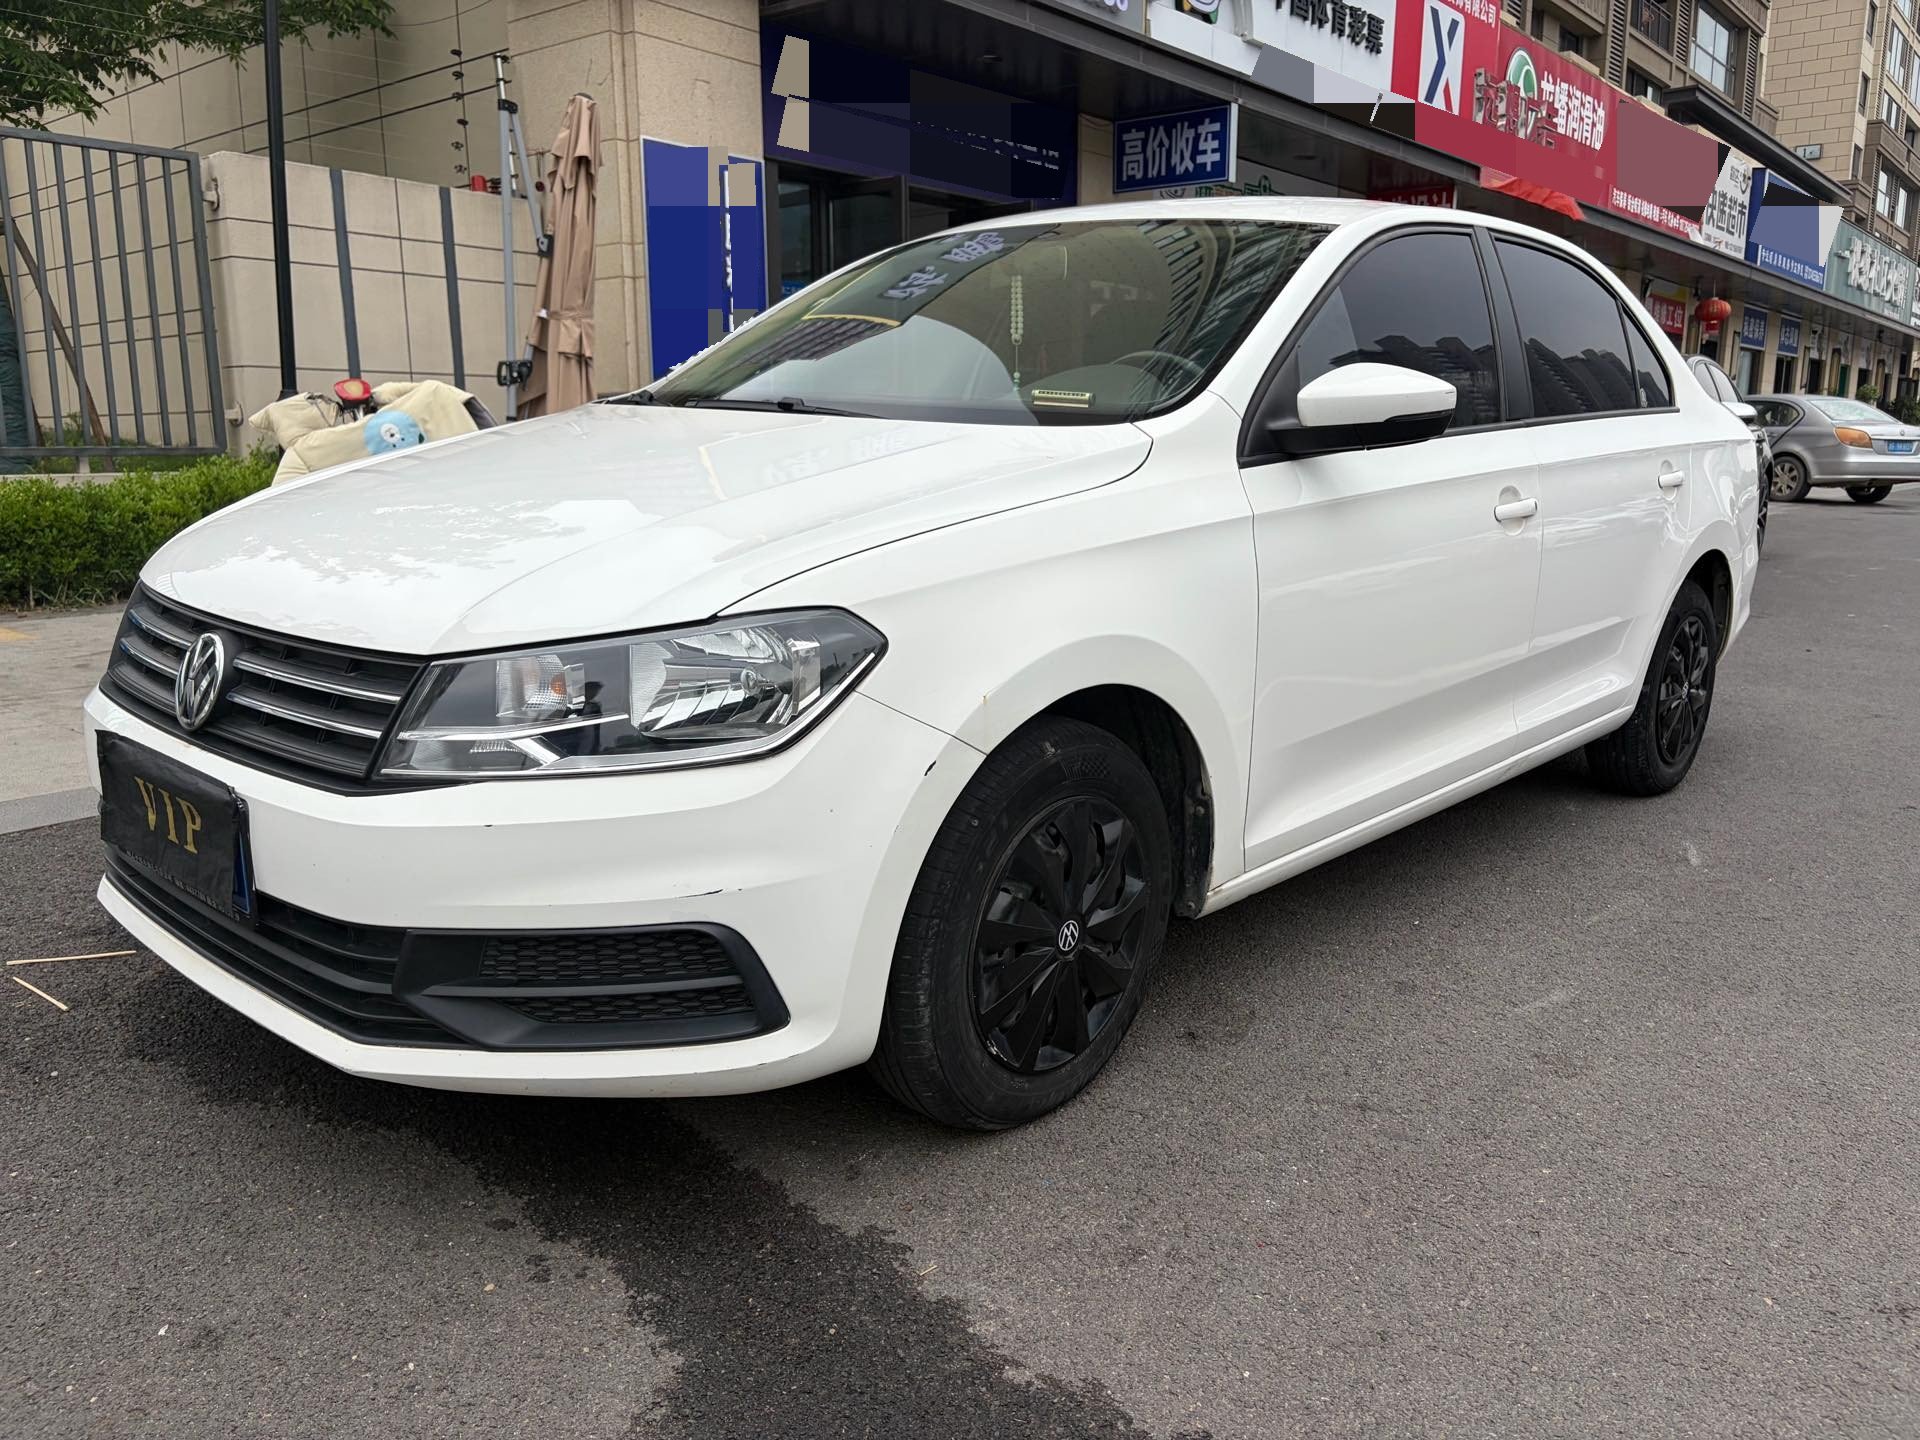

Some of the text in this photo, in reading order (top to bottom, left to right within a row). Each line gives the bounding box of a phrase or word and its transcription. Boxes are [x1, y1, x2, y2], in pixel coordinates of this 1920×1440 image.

[1122, 118, 1221, 182] 高价收车
[133, 776, 202, 855] VIP
